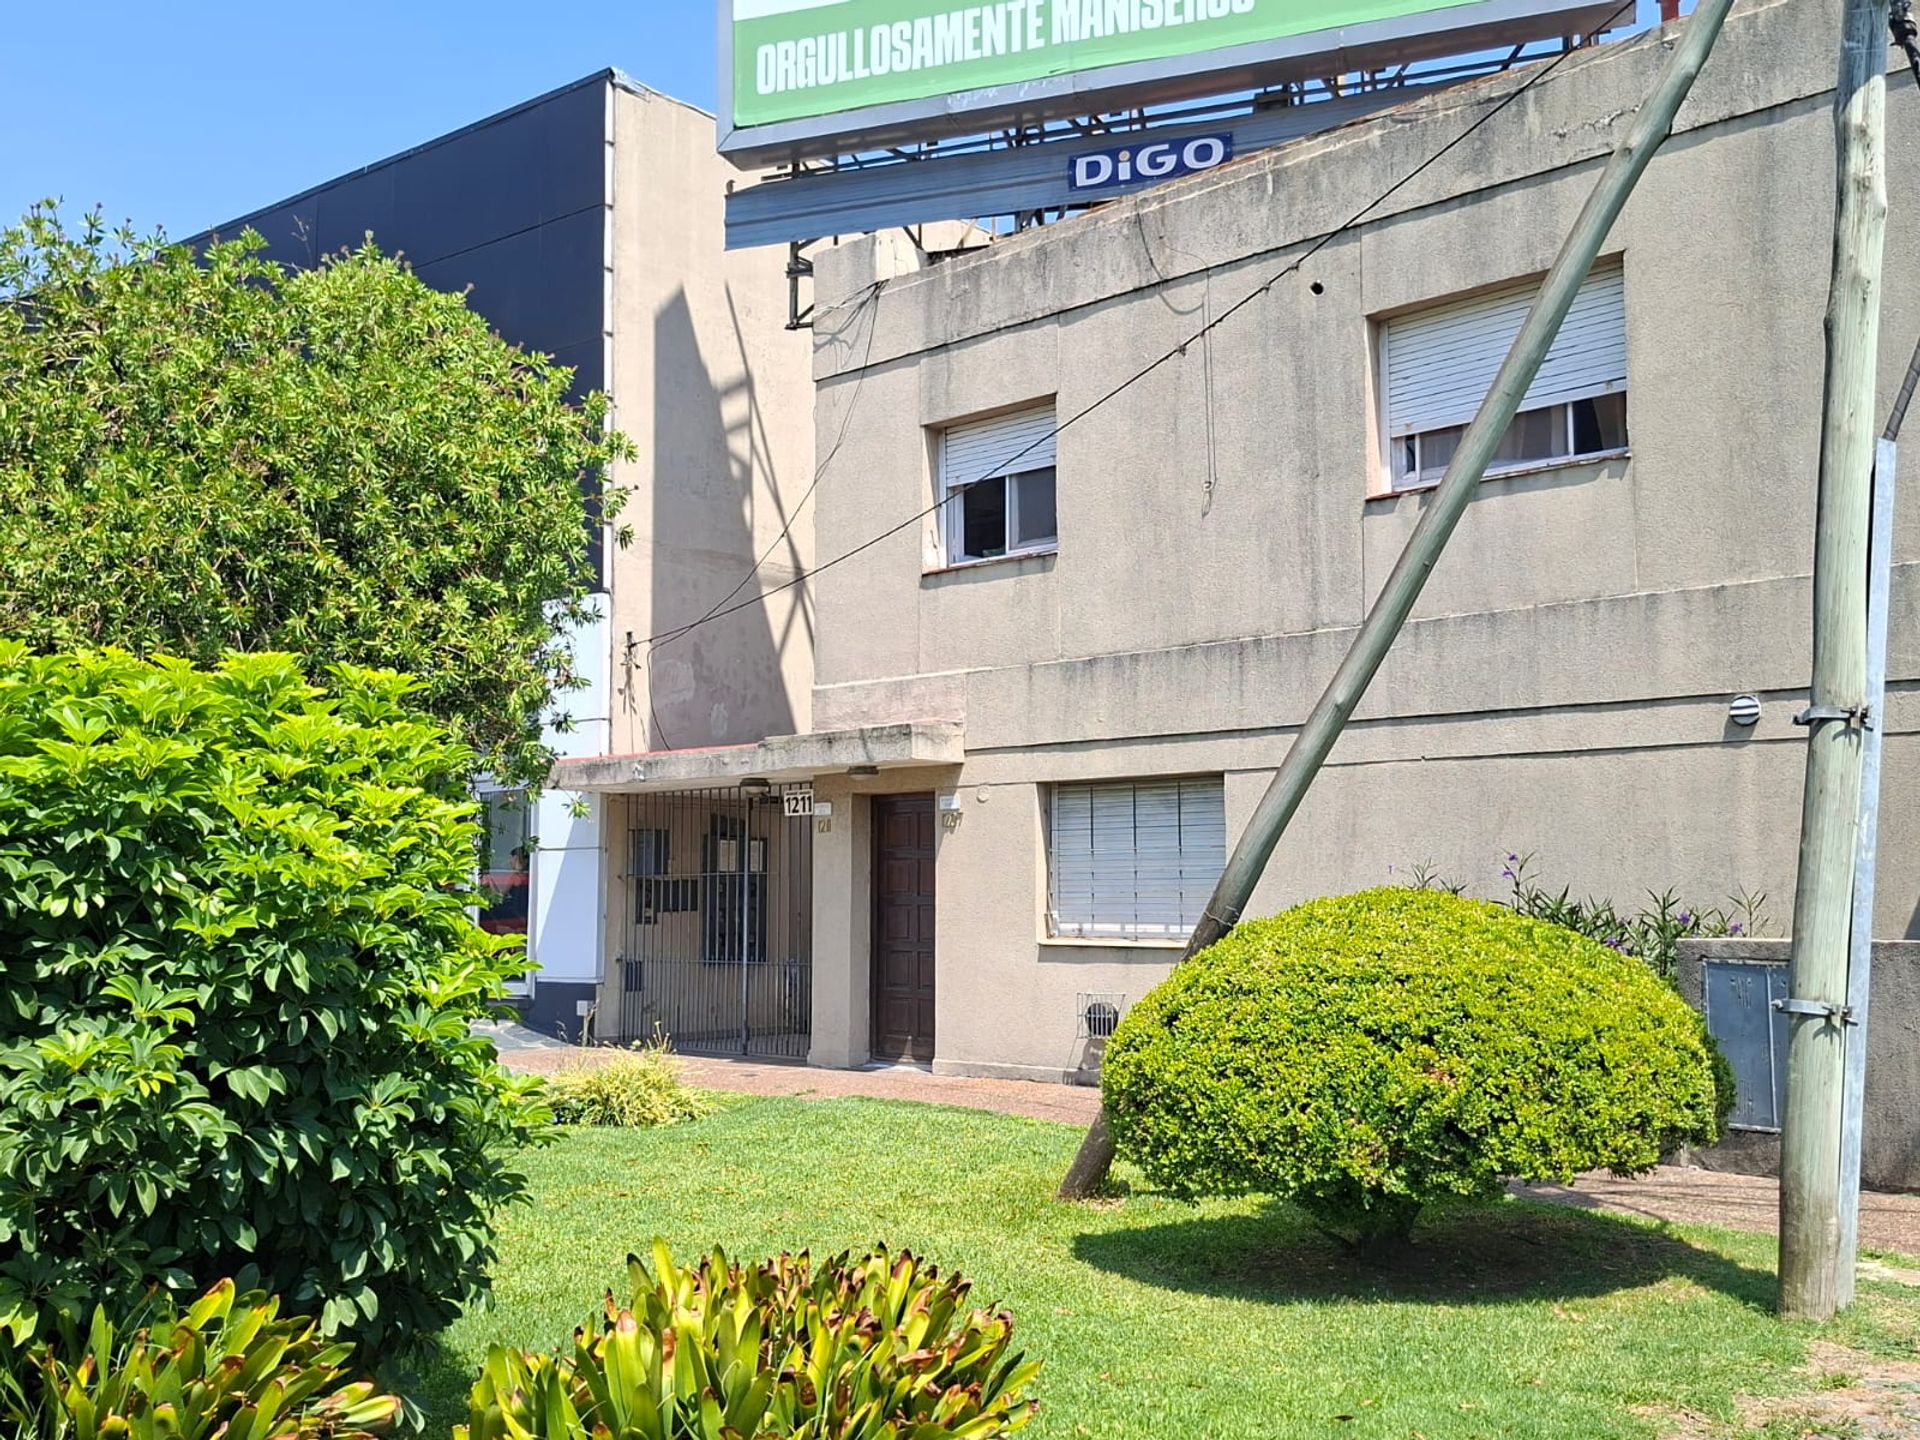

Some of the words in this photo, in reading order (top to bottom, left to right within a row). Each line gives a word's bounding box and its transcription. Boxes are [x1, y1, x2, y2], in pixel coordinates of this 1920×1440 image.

[756, 0, 1046, 95] ORGULLOSAMENTE
[1051, 0, 1256, 45] MANISE
[785, 795, 812, 814] 1211
